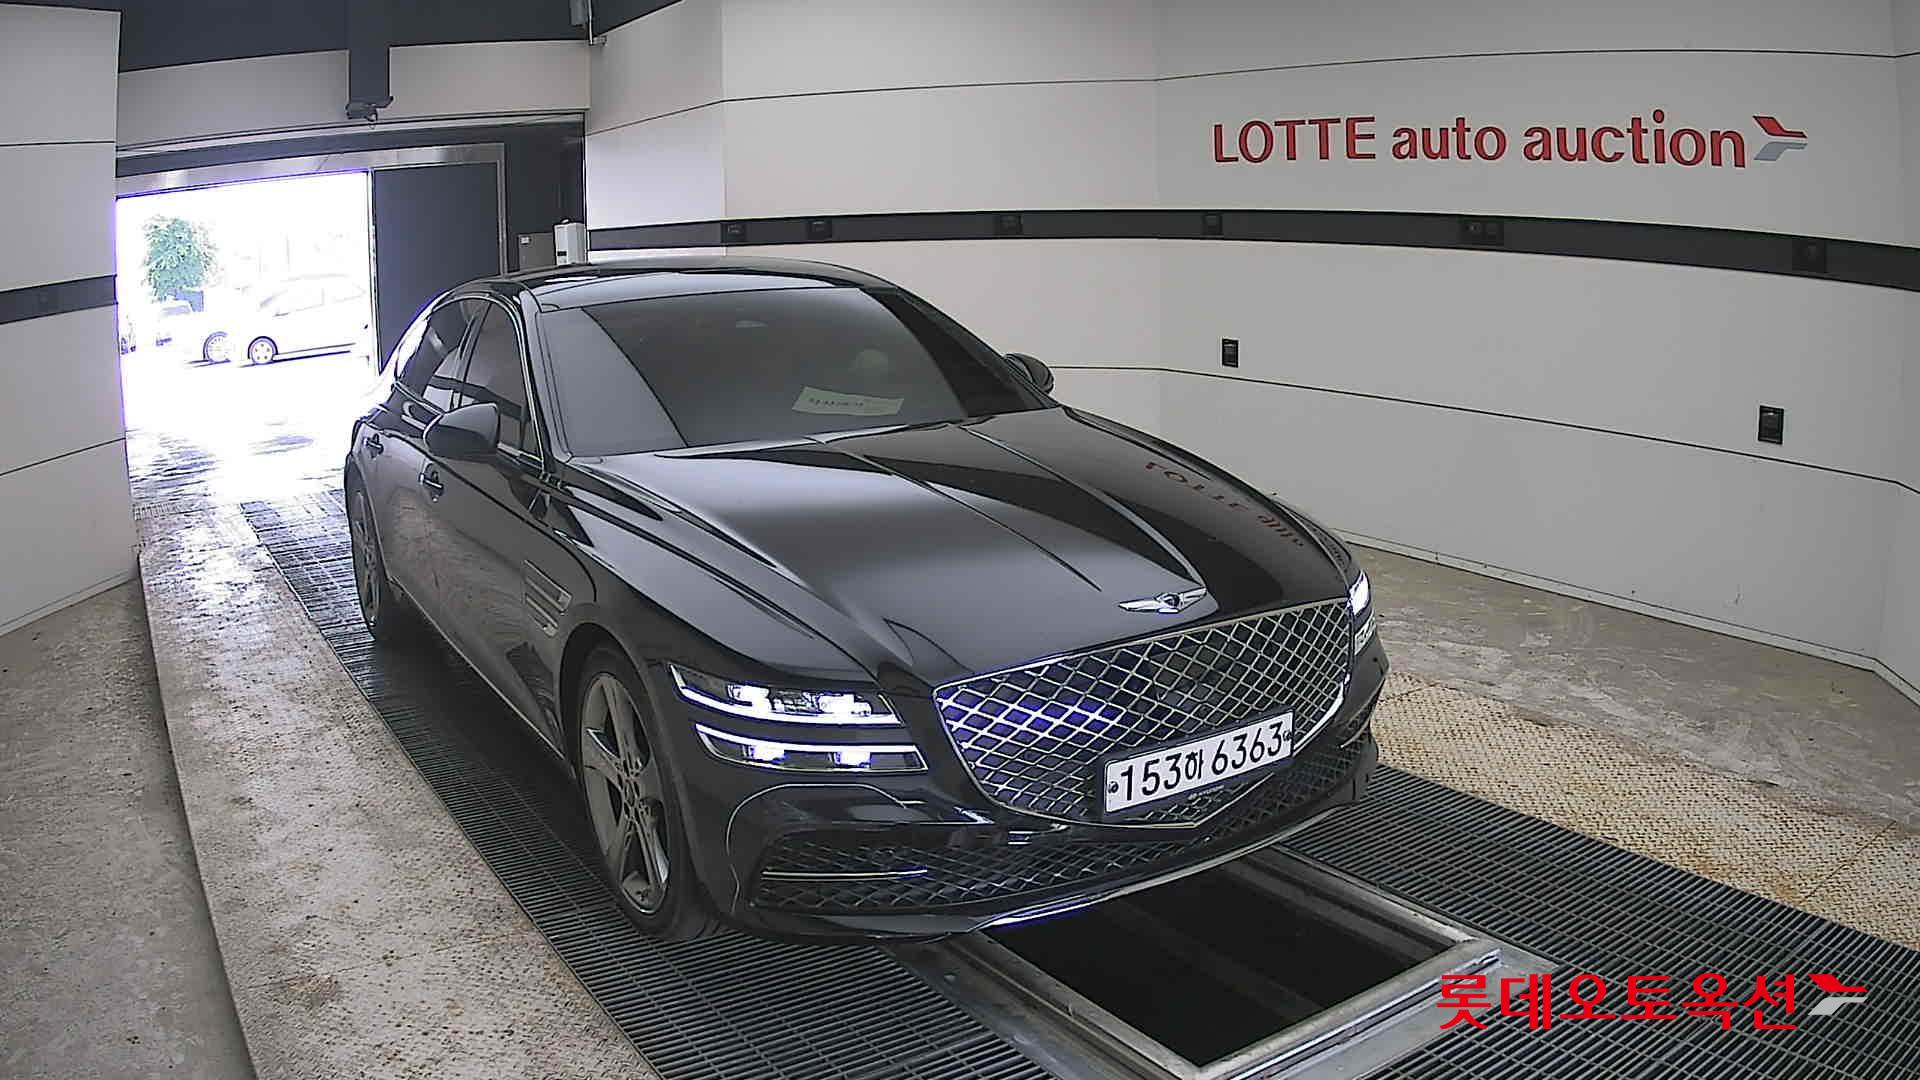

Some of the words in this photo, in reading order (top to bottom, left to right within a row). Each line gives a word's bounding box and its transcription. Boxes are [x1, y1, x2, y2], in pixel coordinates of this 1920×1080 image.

[1213, 116, 1377, 163] LOTTE
[1391, 116, 1507, 161] auto
[1522, 109, 1746, 168] auction
[1120, 749, 1204, 801] 153하
[1211, 722, 1284, 775] 6363
